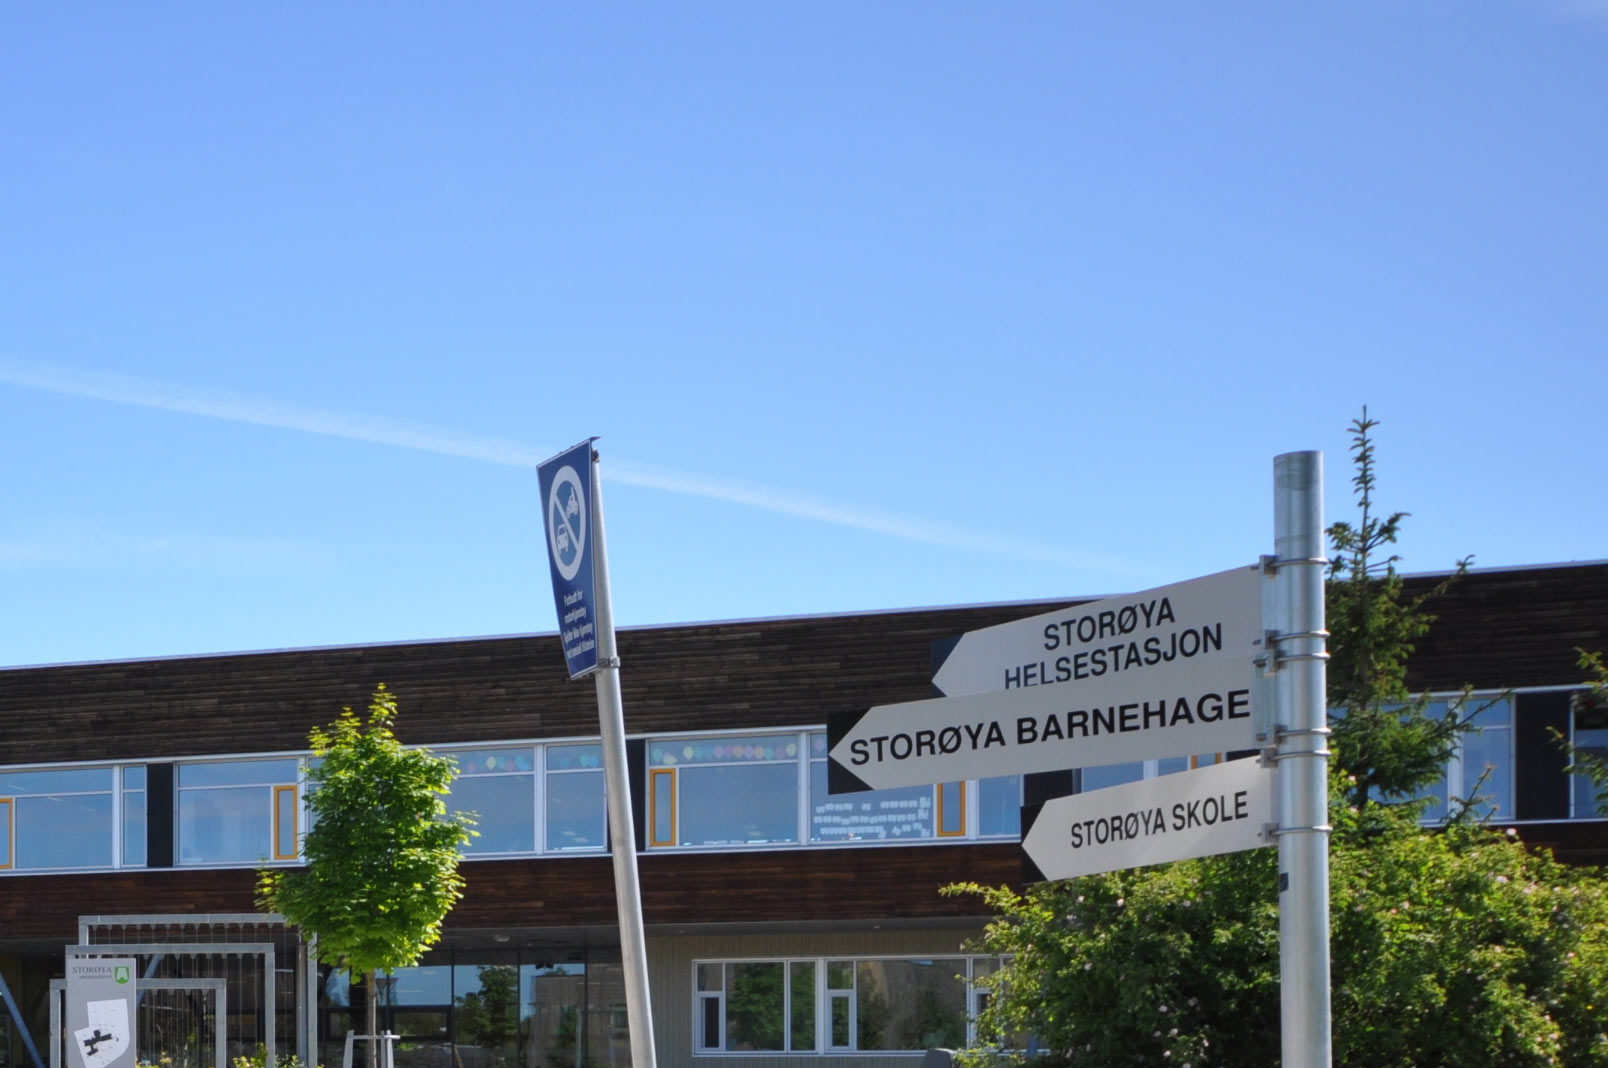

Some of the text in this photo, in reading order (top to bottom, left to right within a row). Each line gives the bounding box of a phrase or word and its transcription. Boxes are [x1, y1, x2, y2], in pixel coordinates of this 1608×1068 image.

[1044, 597, 1175, 650] STORØYA
[1005, 623, 1222, 689] HELSESTASJON
[850, 689, 1250, 765] STORØYA BARNEHAGE
[1070, 790, 1248, 849] STORØYA SKOLE
